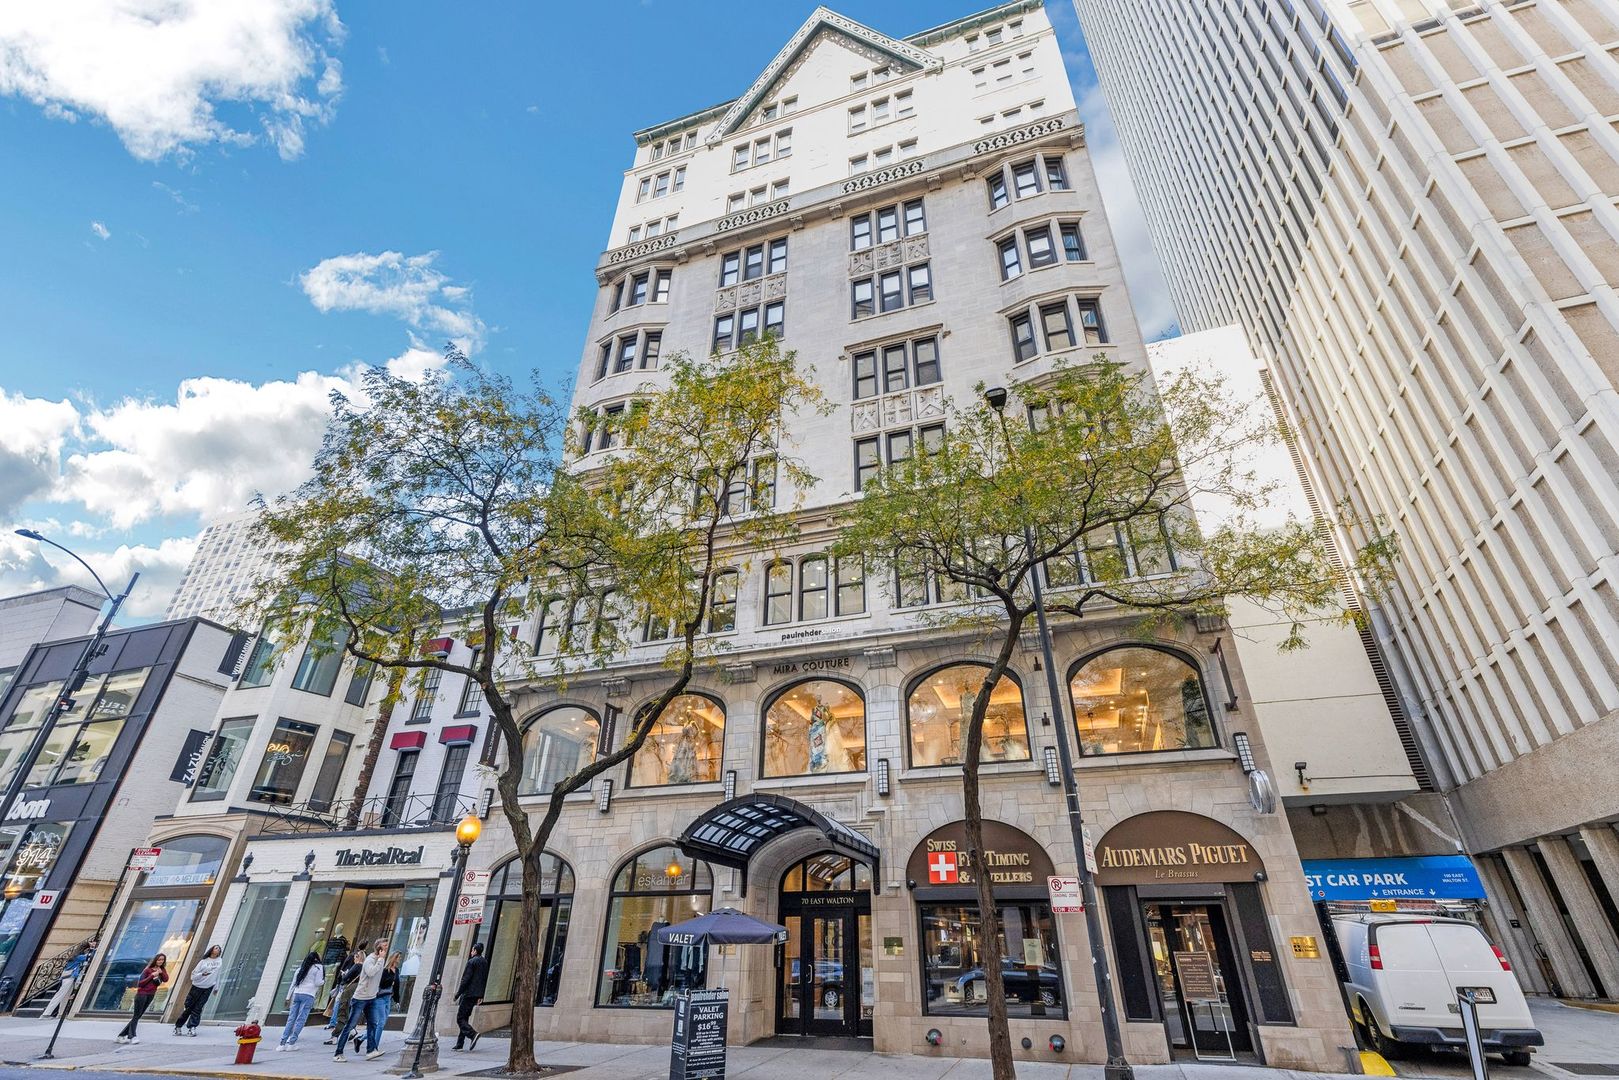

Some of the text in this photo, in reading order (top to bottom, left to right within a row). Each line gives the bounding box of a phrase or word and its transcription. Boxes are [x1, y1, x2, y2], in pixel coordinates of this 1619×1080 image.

[232, 636, 254, 675] WILHELMINA
[773, 657, 850, 674] MIRA COUTURE
[182, 752, 201, 782] ZAZÚ
[927, 838, 957, 852] SWISS
[16, 847, 53, 866] 914
[984, 850, 1030, 867] TIMING
[1101, 846, 1187, 868] AUDEMARS
[1188, 843, 1249, 865] PIGUET
[638, 873, 690, 887] eskandar
[959, 871, 1032, 884] & ELLERS
[1155, 869, 1199, 879] Le Brassus
[1326, 874, 1361, 886] CAR
[1362, 873, 1408, 885] PARK
[1382, 888, 1425, 896] ENTRANCE
[801, 896, 854, 905] 70 EAST WALTON
[669, 932, 695, 944] VALET
[699, 1005, 720, 1013] VALET
[693, 1012, 724, 1020] PARKING
[697, 1022, 711, 1031] $16
